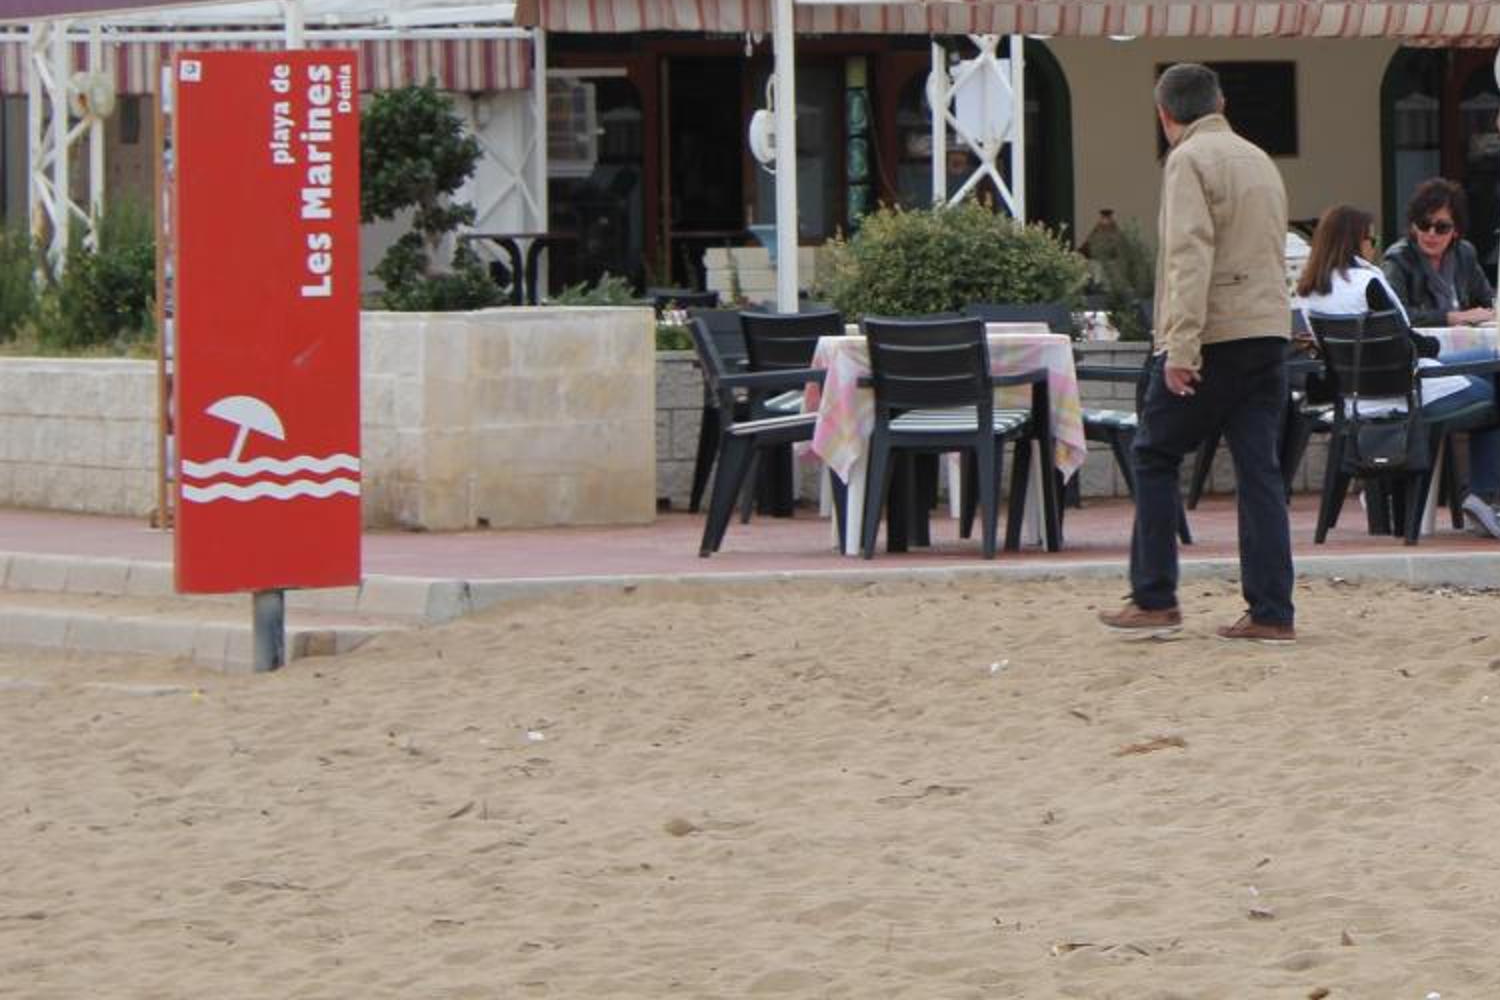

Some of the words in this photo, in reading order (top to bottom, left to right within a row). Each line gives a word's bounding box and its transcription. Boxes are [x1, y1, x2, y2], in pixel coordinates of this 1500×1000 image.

[270, 64, 291, 93] de
[336, 64, 352, 113] Dénia
[269, 102, 295, 164] playa
[300, 65, 332, 219] Marines
[301, 233, 332, 297] Les
